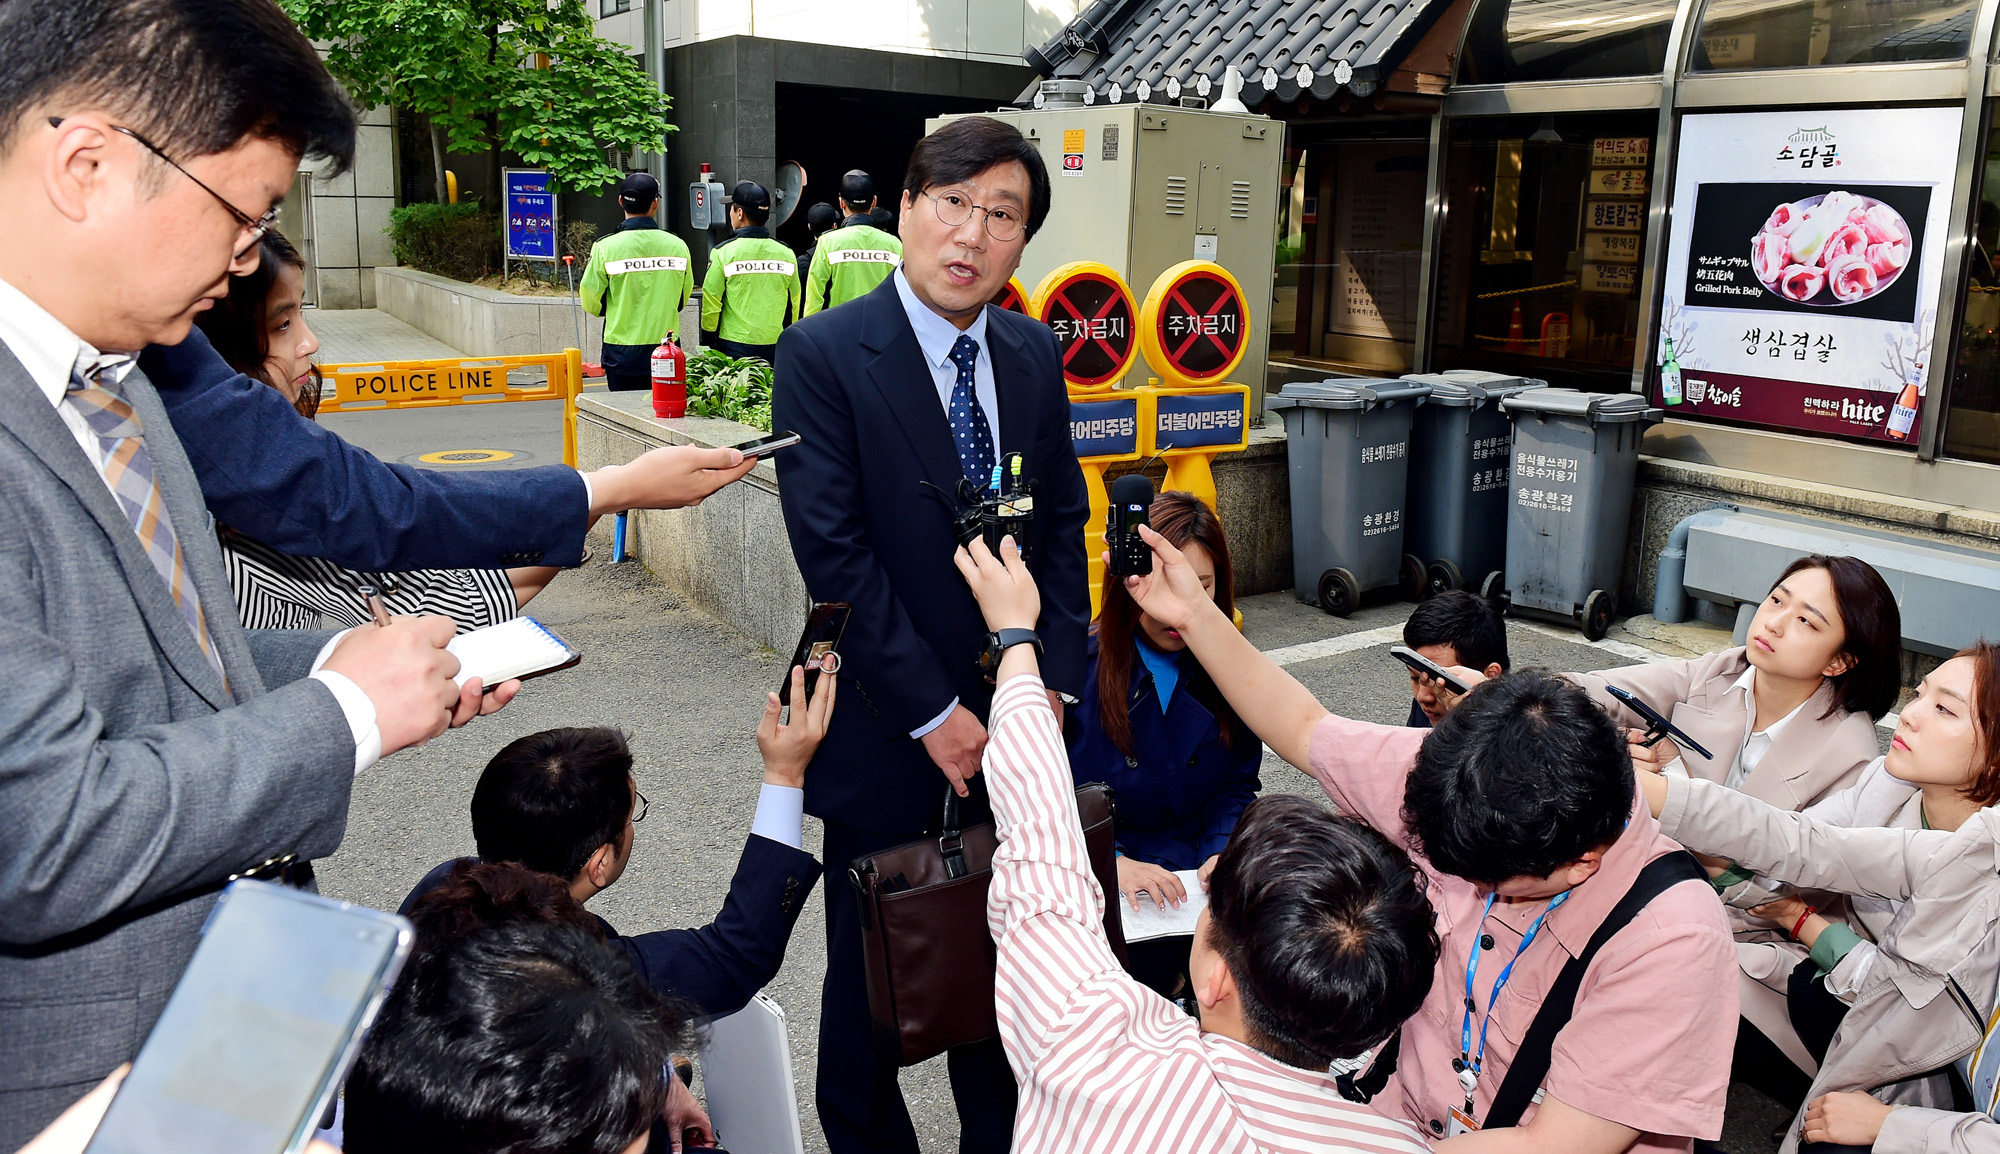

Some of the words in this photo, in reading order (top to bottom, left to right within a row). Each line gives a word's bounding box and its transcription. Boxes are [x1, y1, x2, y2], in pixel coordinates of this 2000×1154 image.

[1776, 144, 1839, 168] 소담골
[624, 259, 676, 270] POLICE
[843, 251, 890, 261] POLICE
[735, 262, 785, 272] POLICE
[1695, 283, 1722, 293] Grilled
[1722, 285, 1741, 295] Pork
[1742, 286, 1763, 298] Belly
[1053, 316, 1125, 342] 주차금지
[1168, 314, 1236, 336] 주차금지
[1740, 327, 1838, 363] 생삼겹살
[356, 373, 437, 395] POLICE
[448, 371, 493, 390] LINE
[1707, 383, 1742, 408] 참이슬
[1803, 397, 1840, 411] 친맥하라
[1841, 397, 1886, 423] hite
[1894, 405, 1914, 419] hite
[1071, 417, 1135, 440] 어민주당
[1158, 409, 1242, 432] 더불어민주당
[1516, 452, 1578, 471] 음식물쓰레기
[1516, 464, 1577, 484] 전용수거용기
[1517, 488, 1573, 506] 송광환경
[1517, 499, 1571, 513] 02)2616-5464
[1363, 510, 1400, 527] 송광환경
